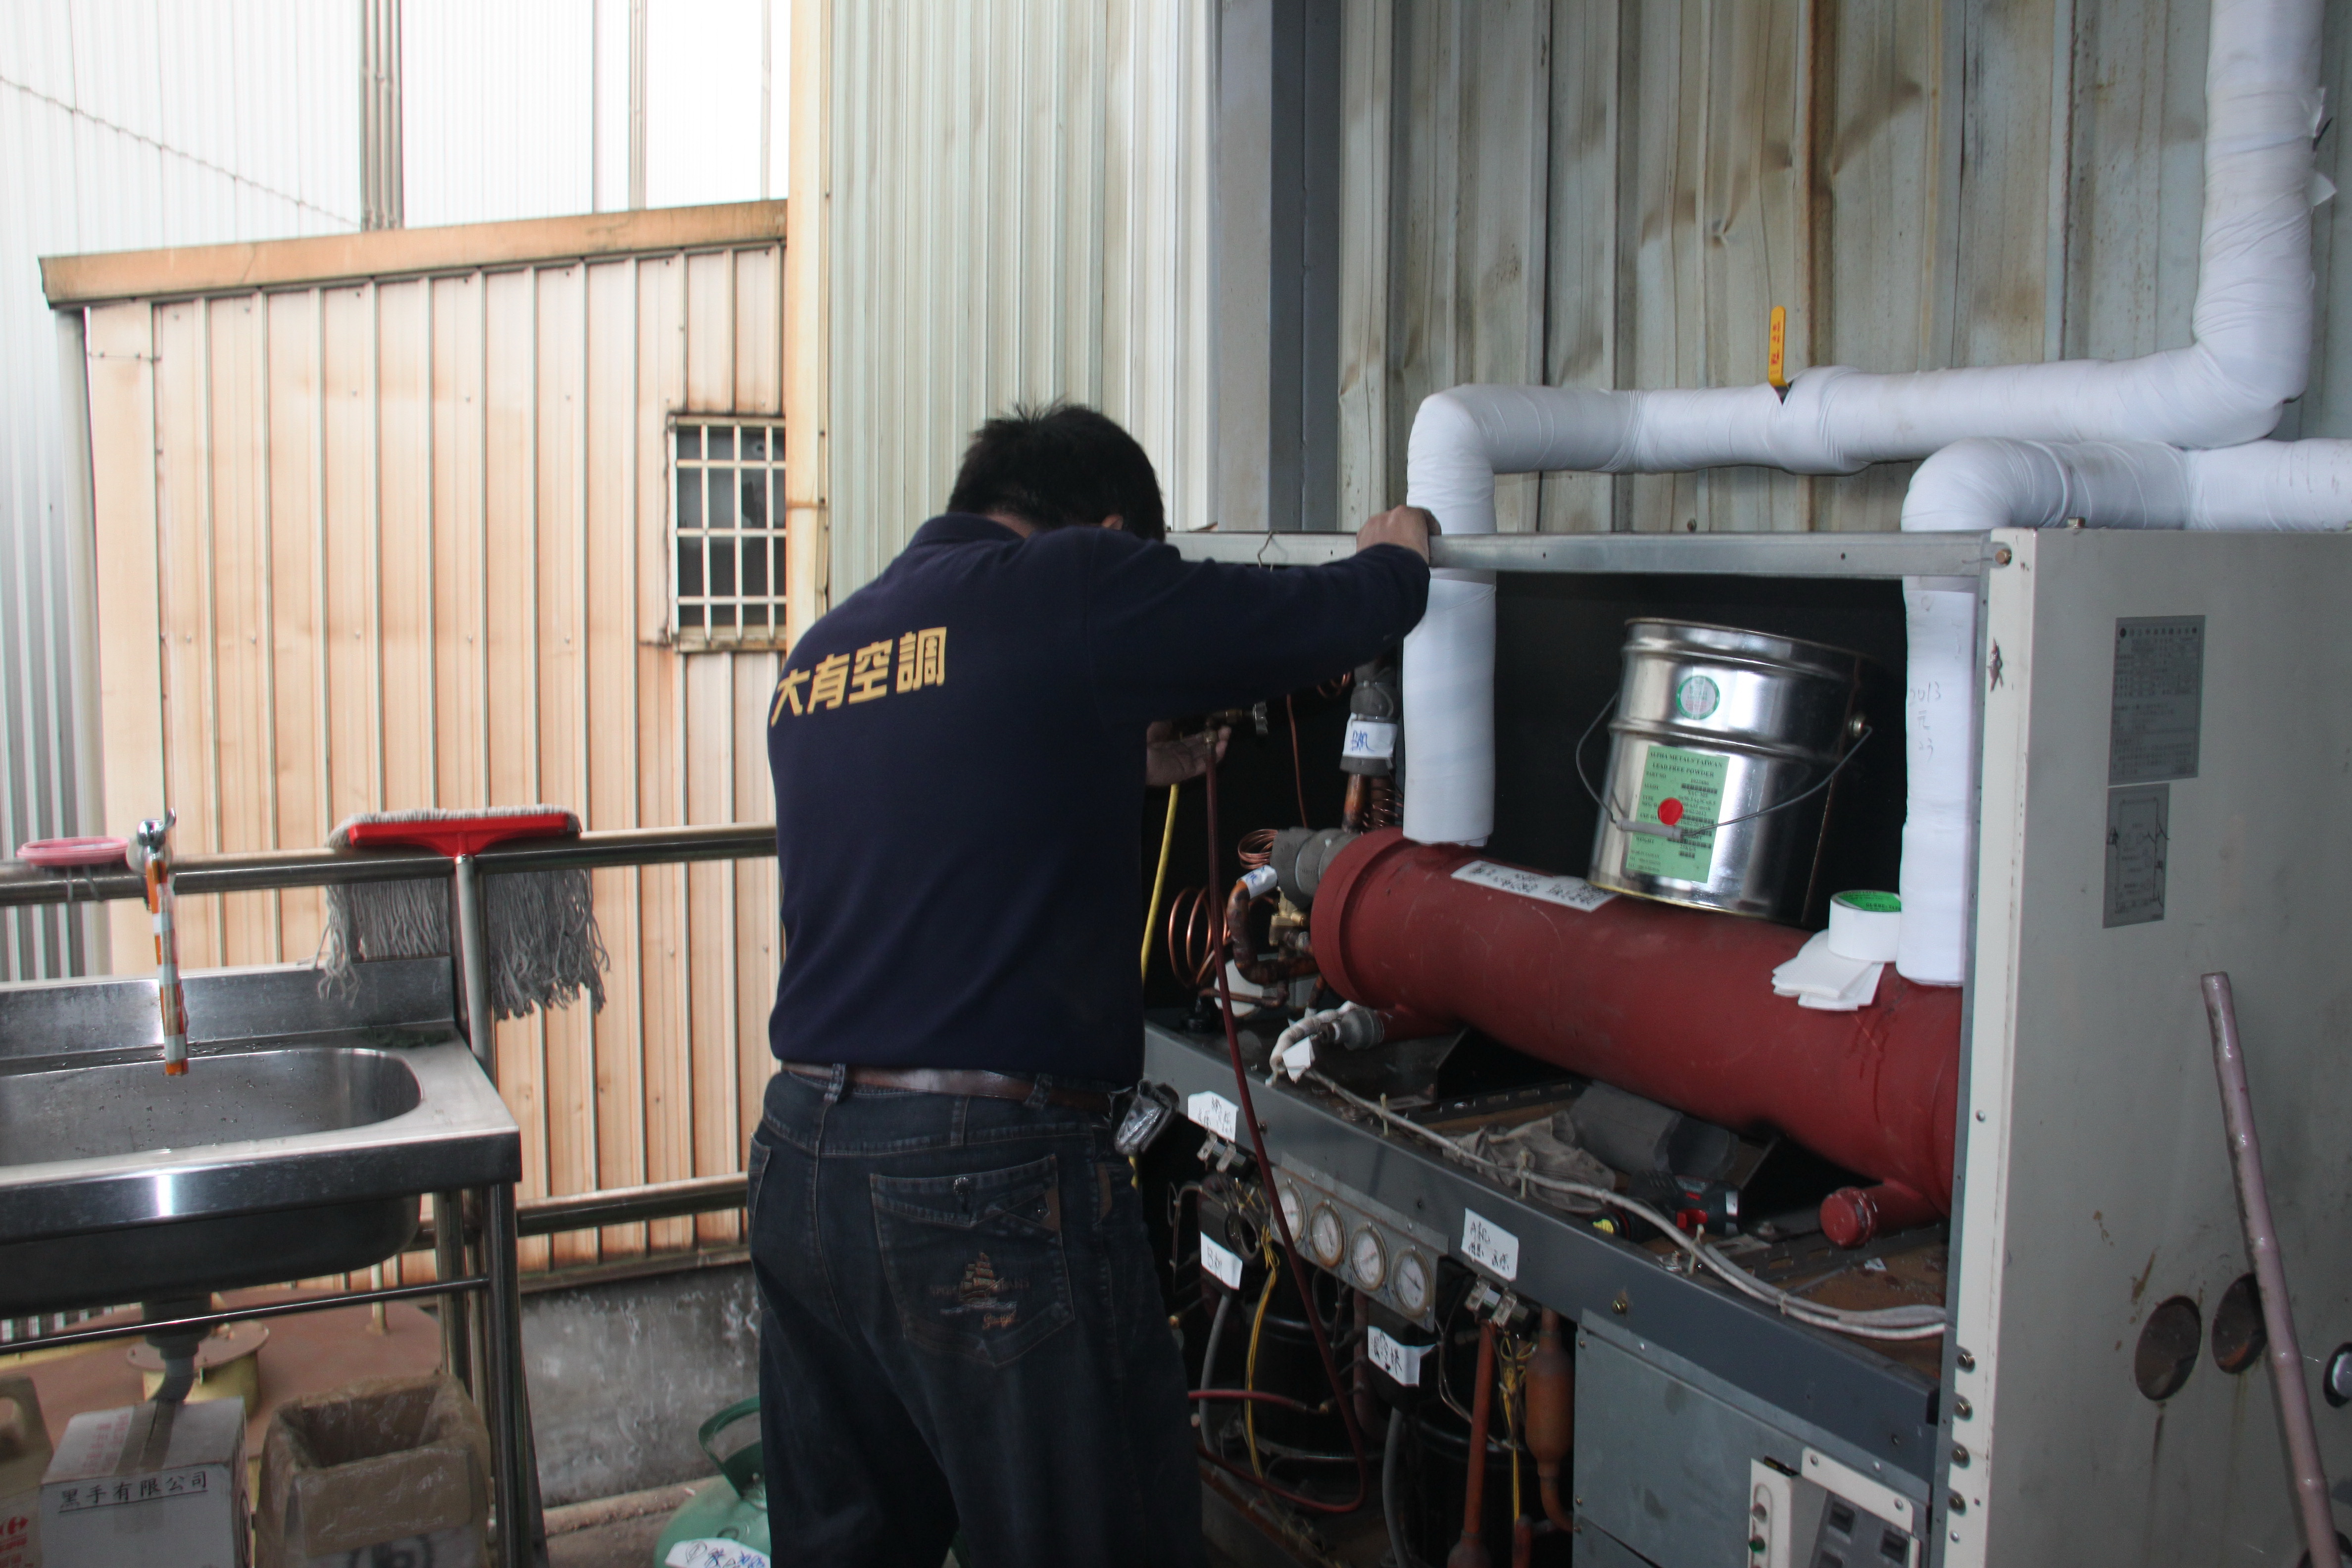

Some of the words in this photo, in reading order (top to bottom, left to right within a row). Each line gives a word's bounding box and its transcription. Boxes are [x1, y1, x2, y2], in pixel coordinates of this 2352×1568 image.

[771, 626, 947, 728] 大有空調
[1650, 751, 1667, 760] ALPHA
[1670, 753, 1695, 763] METALS
[1696, 758, 1723, 769] TAIWAN
[1653, 762, 1668, 770] LEAD
[1669, 765, 1684, 773] FREE
[1686, 767, 1715, 778] POWDER
[60, 1470, 207, 1509] 黑手有限公司
